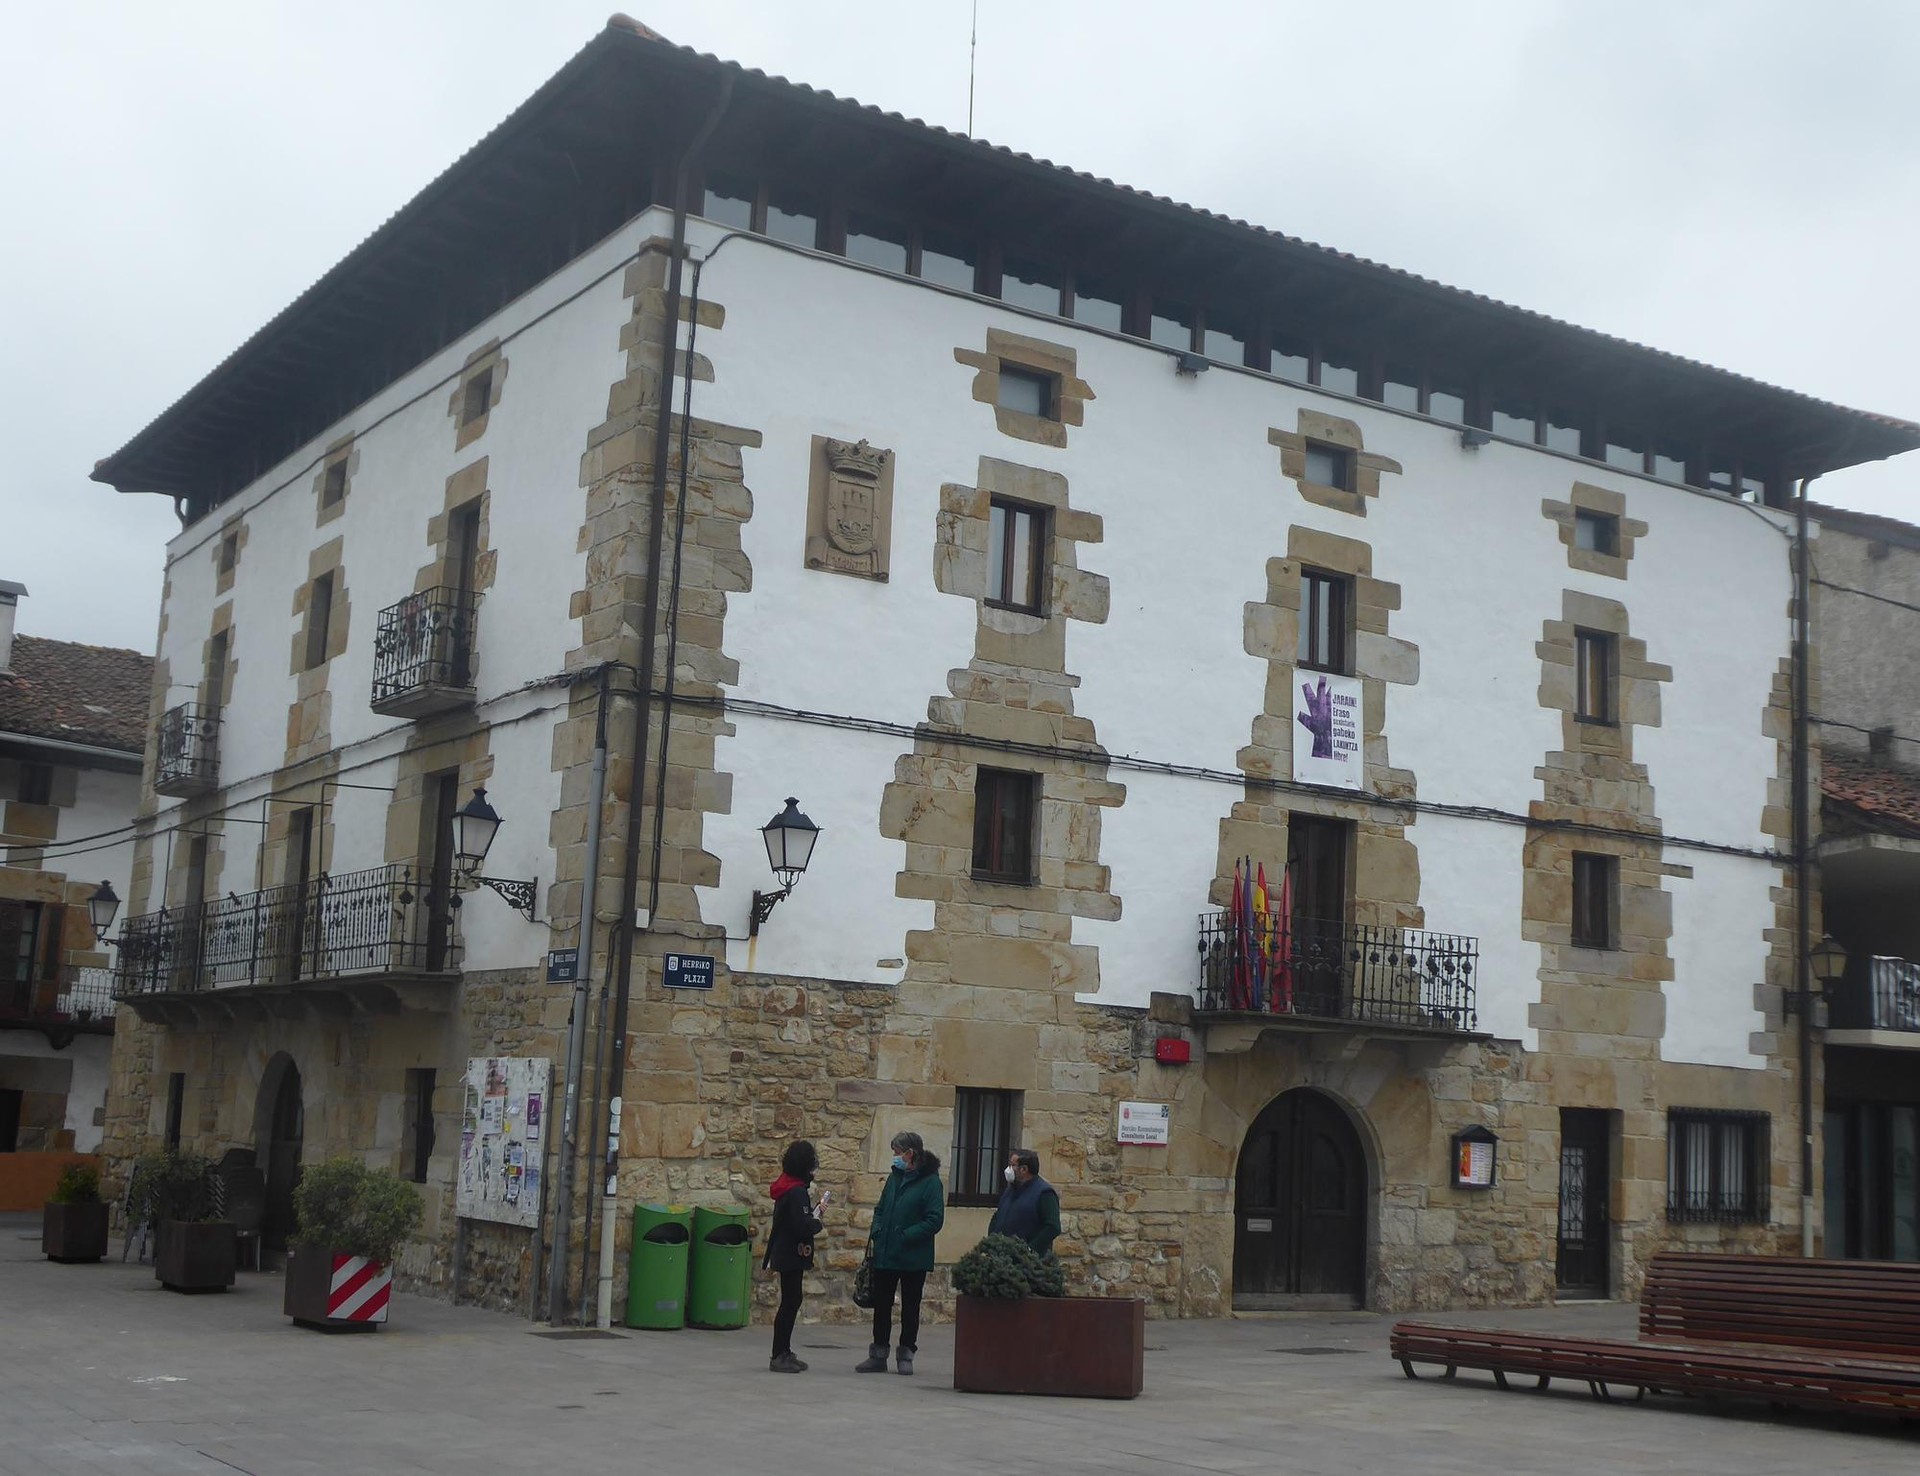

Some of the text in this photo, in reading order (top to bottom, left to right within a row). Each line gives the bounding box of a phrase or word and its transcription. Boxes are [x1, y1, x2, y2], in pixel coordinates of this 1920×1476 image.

[1333, 707, 1350, 718] Eraso
[1333, 727, 1356, 739] gabeko
[1333, 739, 1358, 751] LAKUNTZA
[683, 974, 706, 984] PLAZA
